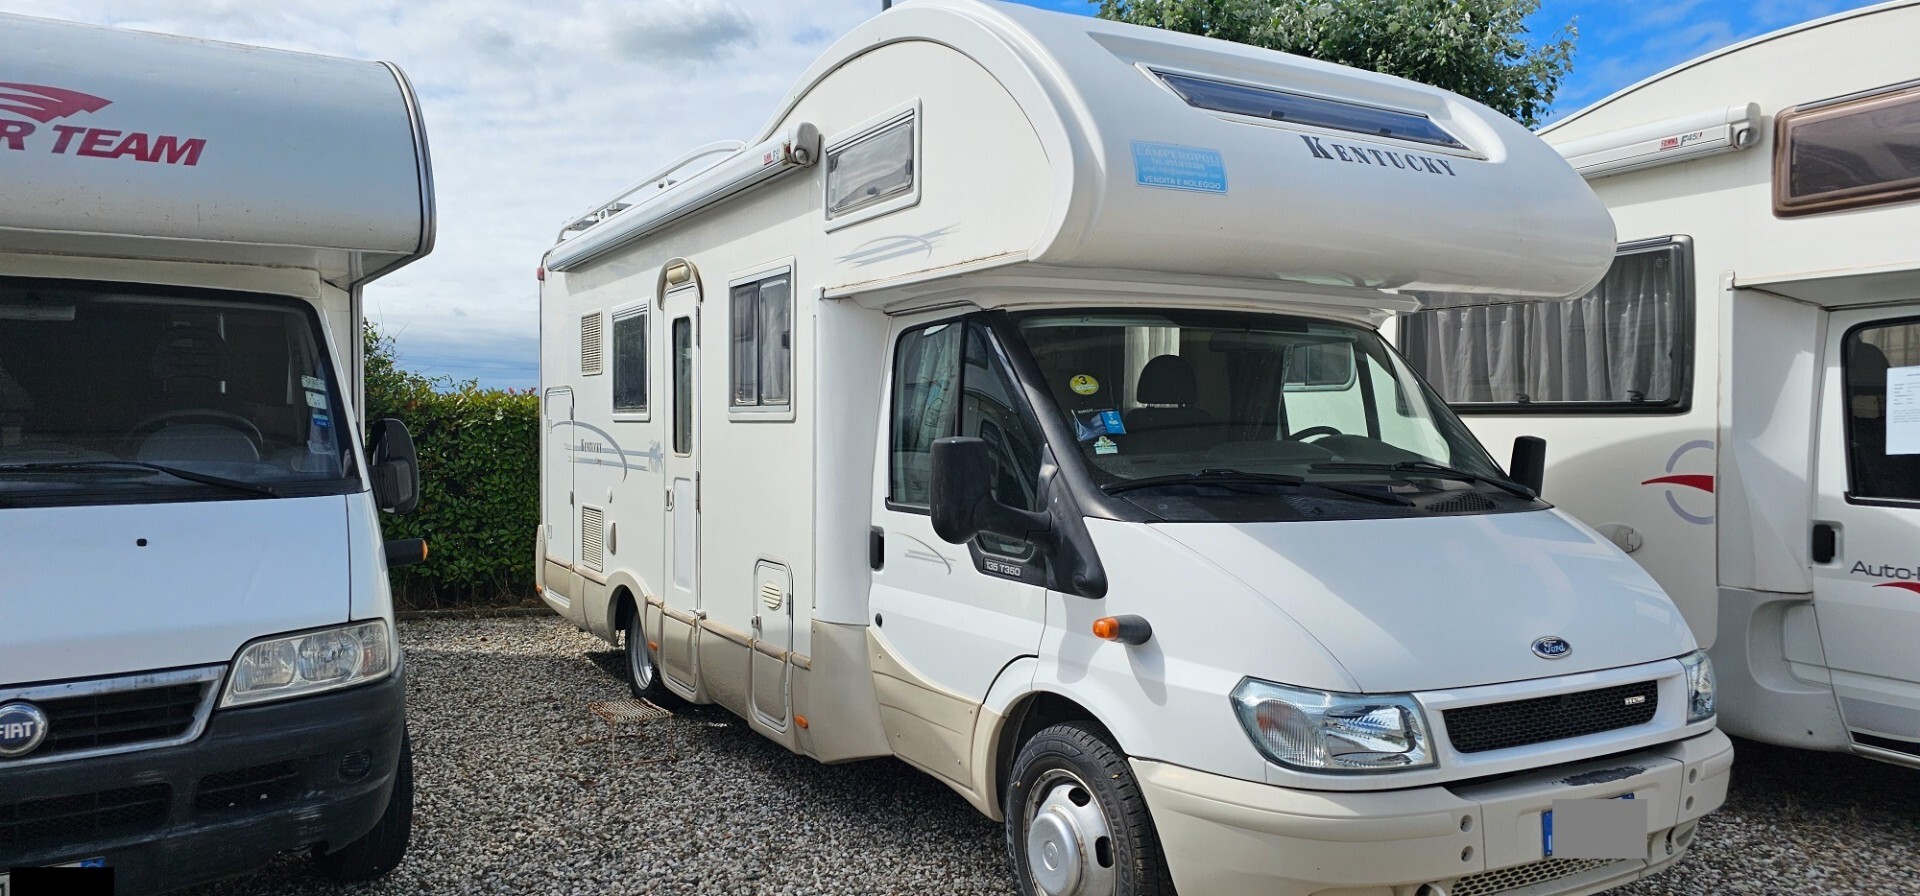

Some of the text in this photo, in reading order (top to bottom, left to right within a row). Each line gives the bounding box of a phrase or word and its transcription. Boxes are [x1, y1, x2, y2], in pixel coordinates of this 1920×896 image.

[51, 125, 207, 166] TEAM
[1300, 135, 1456, 176] KENTUCKY
[1144, 176, 1176, 185] VENDITA
[1183, 180, 1221, 190] NOLEGGIO
[1078, 375, 1088, 385] 3
[986, 561, 1021, 576] 135 T350
[1850, 560, 1920, 581] Auto-
[1544, 640, 1566, 653] Ford
